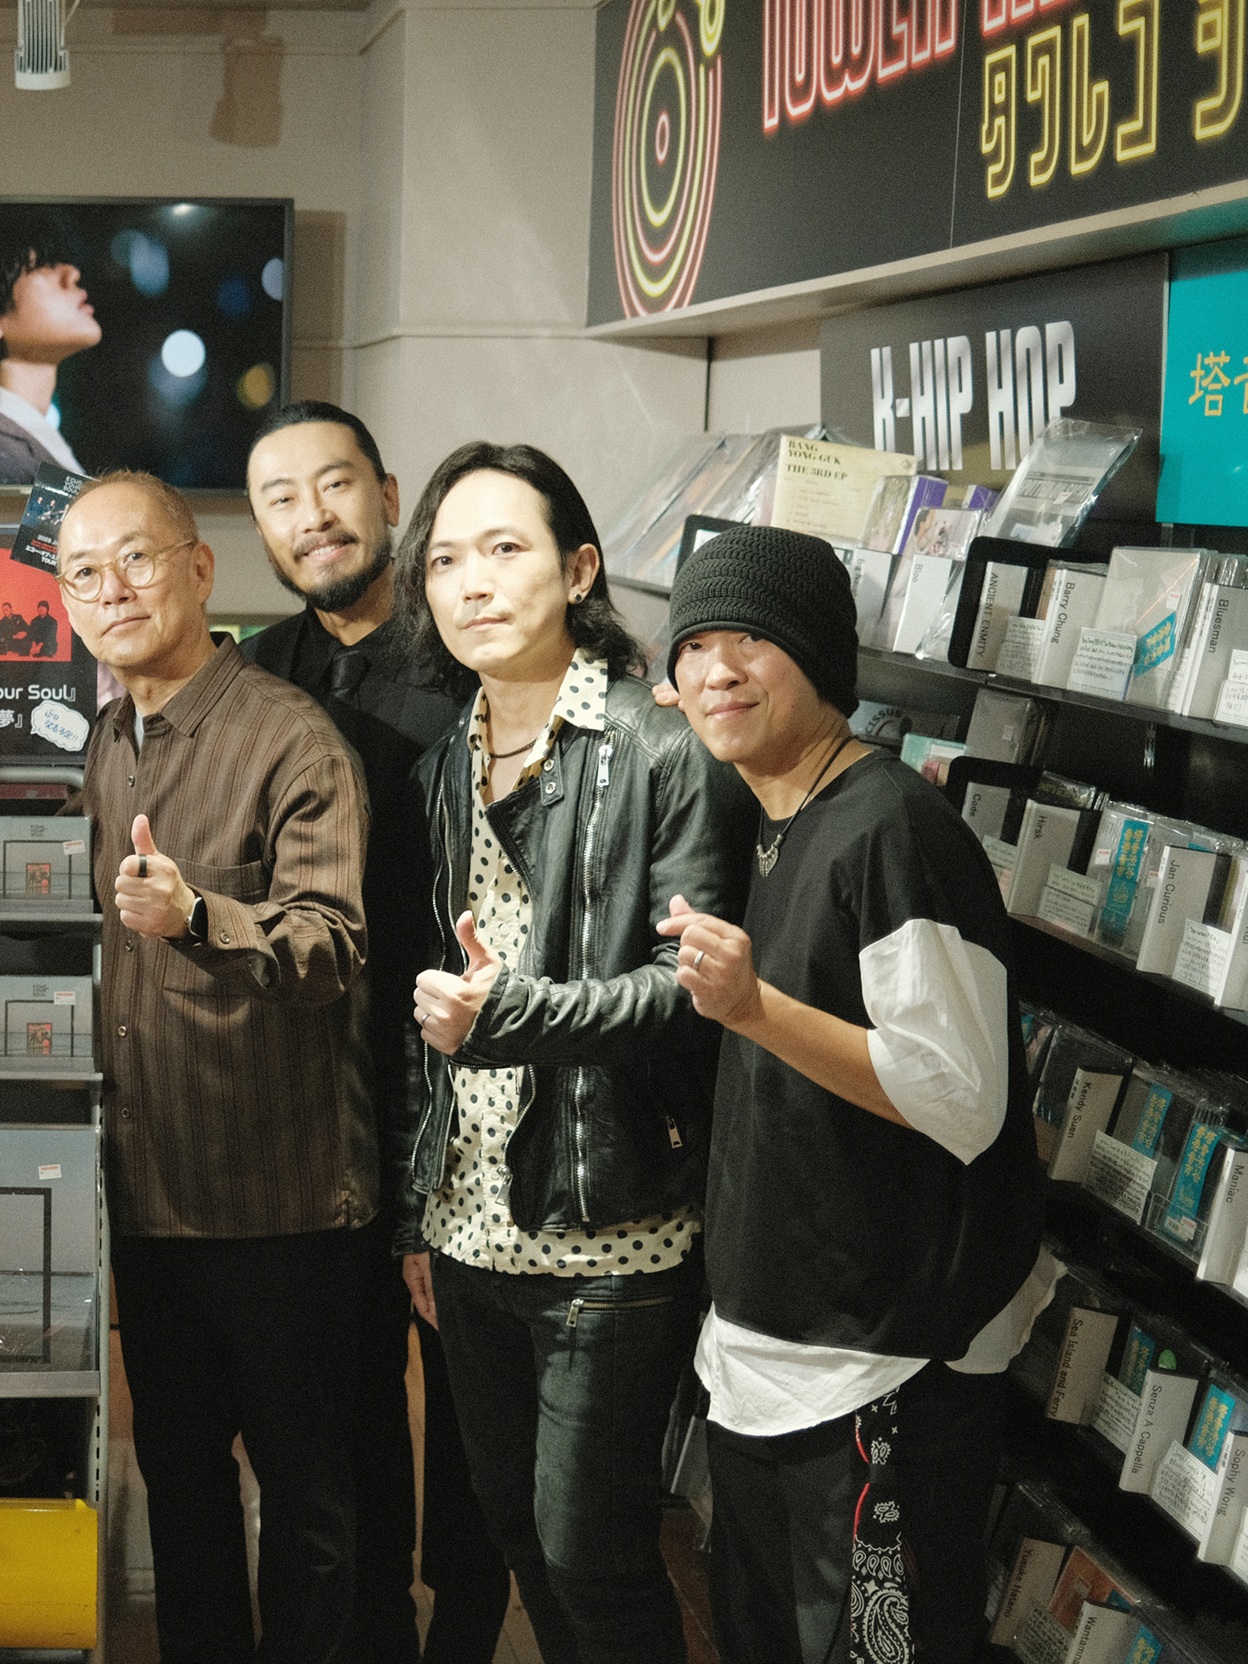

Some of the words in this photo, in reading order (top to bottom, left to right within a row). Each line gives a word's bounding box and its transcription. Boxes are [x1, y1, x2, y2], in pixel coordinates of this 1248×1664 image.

[870, 336, 974, 470] K-HIP
[985, 321, 1077, 470] HOP
[786, 464, 809, 475] THE
[834, 471, 848, 481] EP
[985, 571, 999, 616] ANCIENT
[1063, 581, 1076, 612] Barry
[977, 616, 992, 659] ENMITY
[1050, 613, 1068, 644] Chung
[1208, 598, 1230, 653] Bluesman
[968, 793, 982, 818] Code
[1033, 815, 1048, 840] Hirsk
[1170, 859, 1180, 880] Jan
[1158, 882, 1176, 925] Curious
[1076, 1081, 1092, 1115] Kendy
[1067, 1114, 1082, 1140] Suen
[1225, 1164, 1245, 1204] Maniac
[1071, 1318, 1083, 1334] Sea
[1066, 1335, 1080, 1367] Island
[1062, 1367, 1075, 1386] and
[1146, 1384, 1163, 1416] Senza
[1130, 1431, 1152, 1475] Cappella
[1227, 1448, 1246, 1481] Sophy
[1216, 1483, 1239, 1517] Wong
[1016, 1549, 1033, 1582] Yusuke
